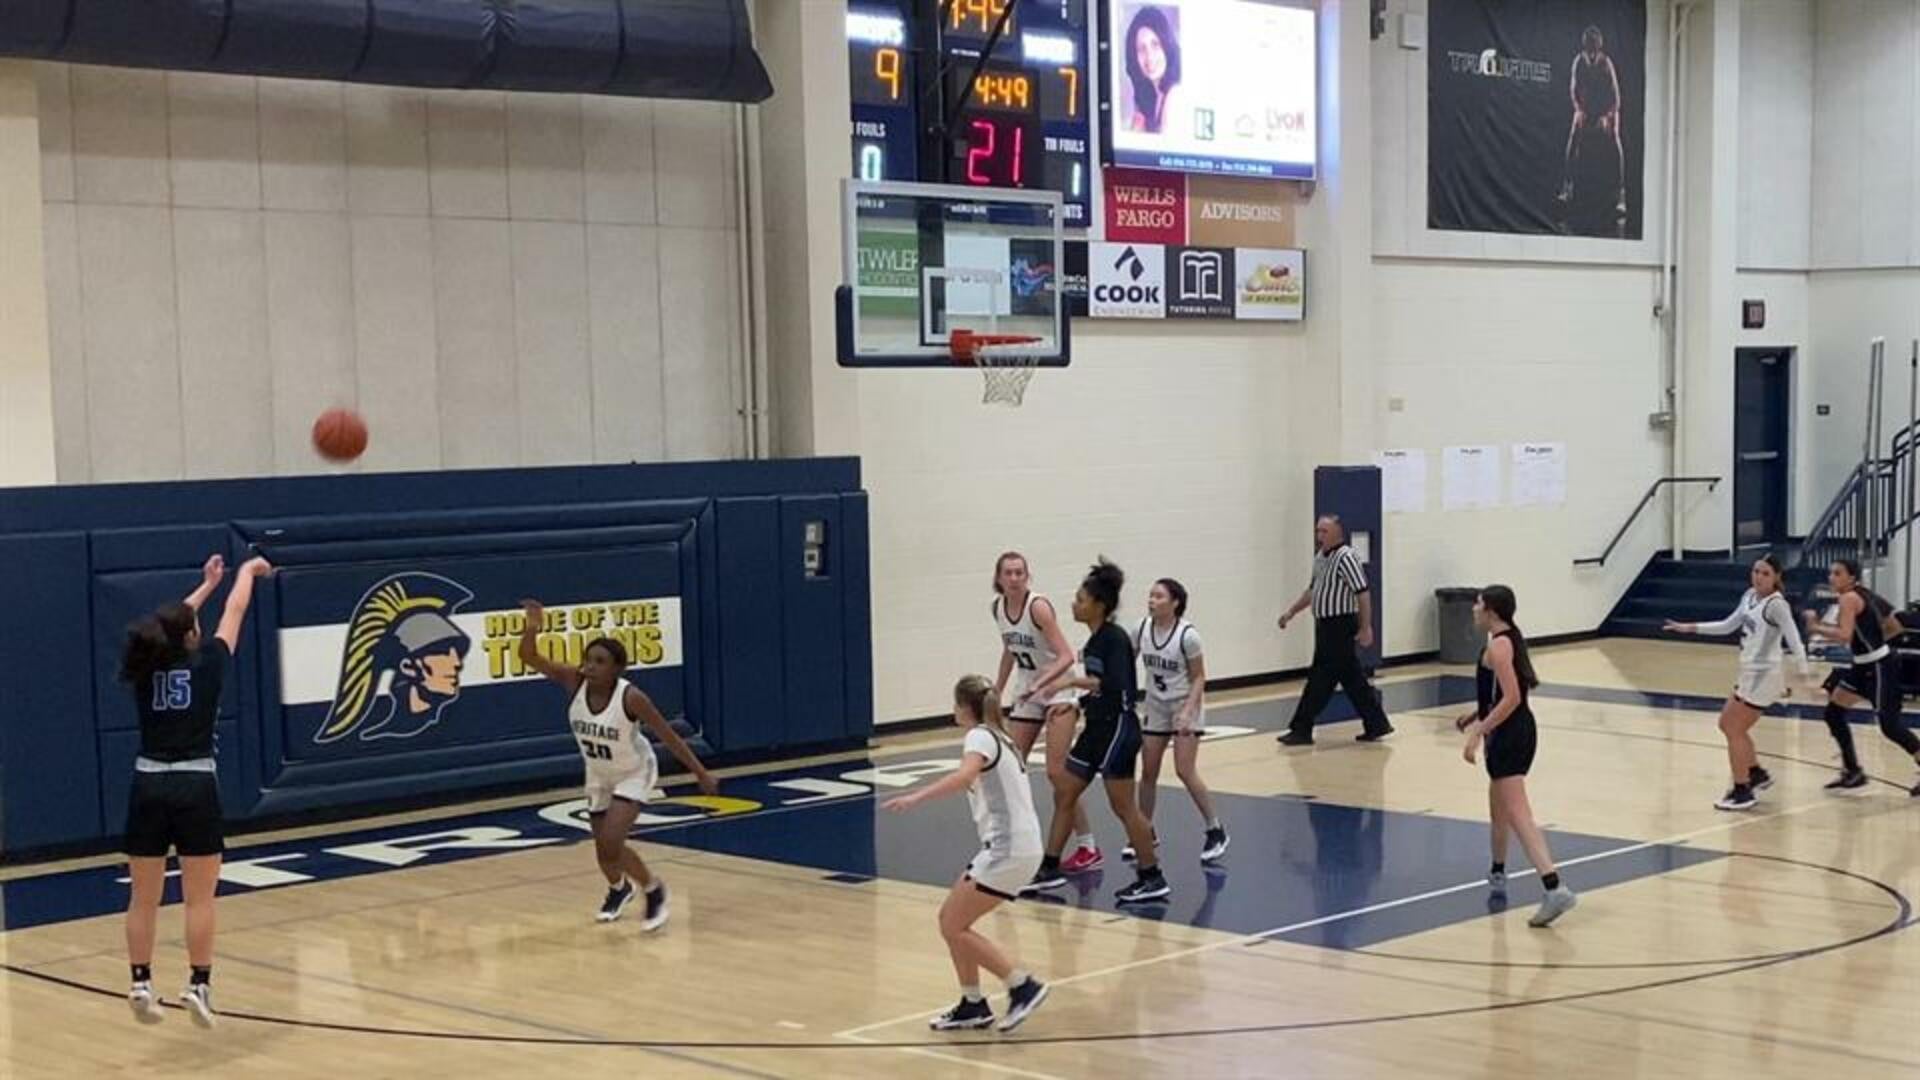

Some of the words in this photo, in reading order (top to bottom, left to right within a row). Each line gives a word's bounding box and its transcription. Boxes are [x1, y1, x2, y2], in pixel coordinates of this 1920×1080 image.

[877, 49, 899, 99] 9
[974, 75, 1029, 108] 4:49
[1058, 66, 1077, 117] 7
[967, 121, 1022, 184] 21
[1059, 139, 1085, 153] FOULS
[860, 144, 882, 183] 0
[1114, 185, 1176, 206] WELLS
[1117, 208, 1175, 228] FARGO
[1201, 201, 1282, 223] ADVISORS
[1094, 284, 1160, 304] COOK
[571, 606, 605, 629] OF
[608, 602, 659, 626] THE
[483, 625, 663, 679] TOJNS
[152, 669, 191, 711] 15
[1153, 673, 1168, 692] 5
